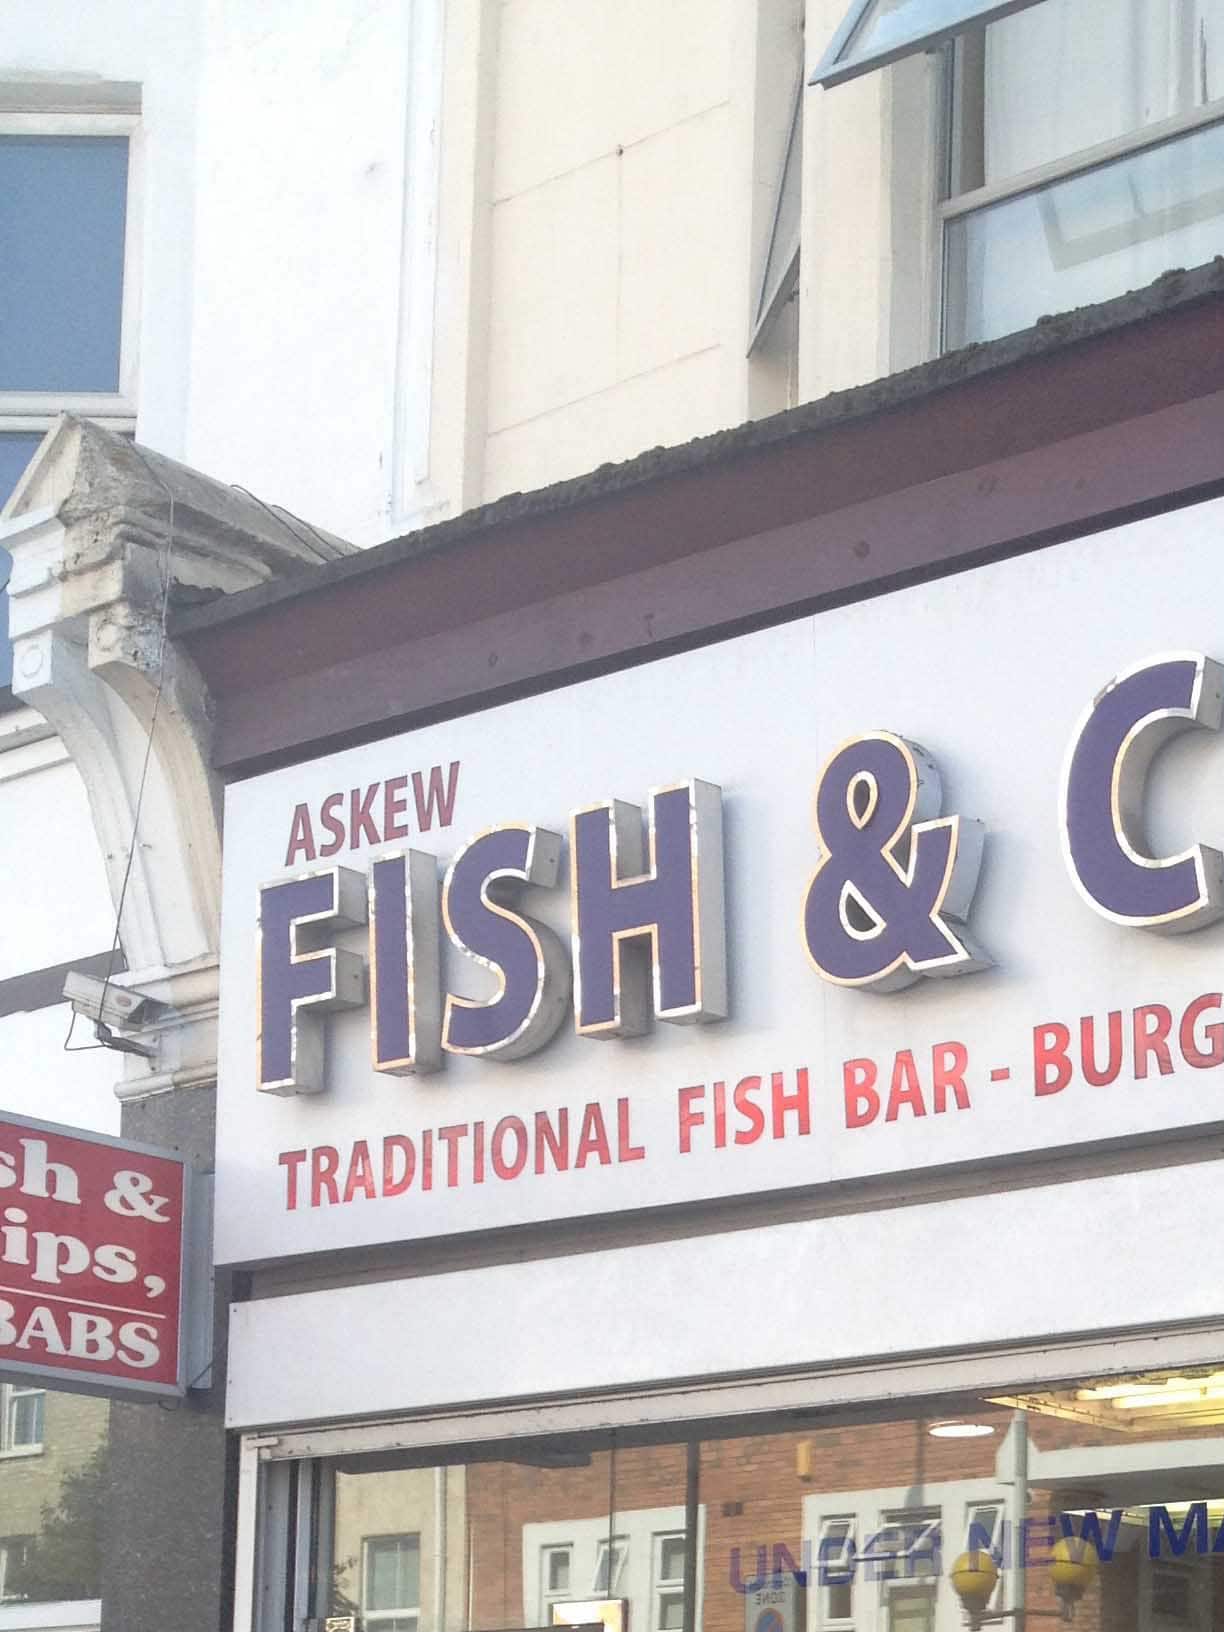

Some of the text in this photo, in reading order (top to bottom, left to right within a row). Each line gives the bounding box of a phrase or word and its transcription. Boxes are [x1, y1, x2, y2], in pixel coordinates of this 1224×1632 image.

[284, 760, 460, 866] ASKEW
[256, 778, 728, 1096] FISH
[800, 729, 998, 993] &
[278, 1096, 646, 1211] TRADITIONAL
[678, 1066, 811, 1154] FISH
[843, 1041, 972, 1129] BAR
[104, 1169, 171, 1223] &
[729, 1524, 942, 1594] UNDER
[967, 1509, 1127, 1570] NEW
